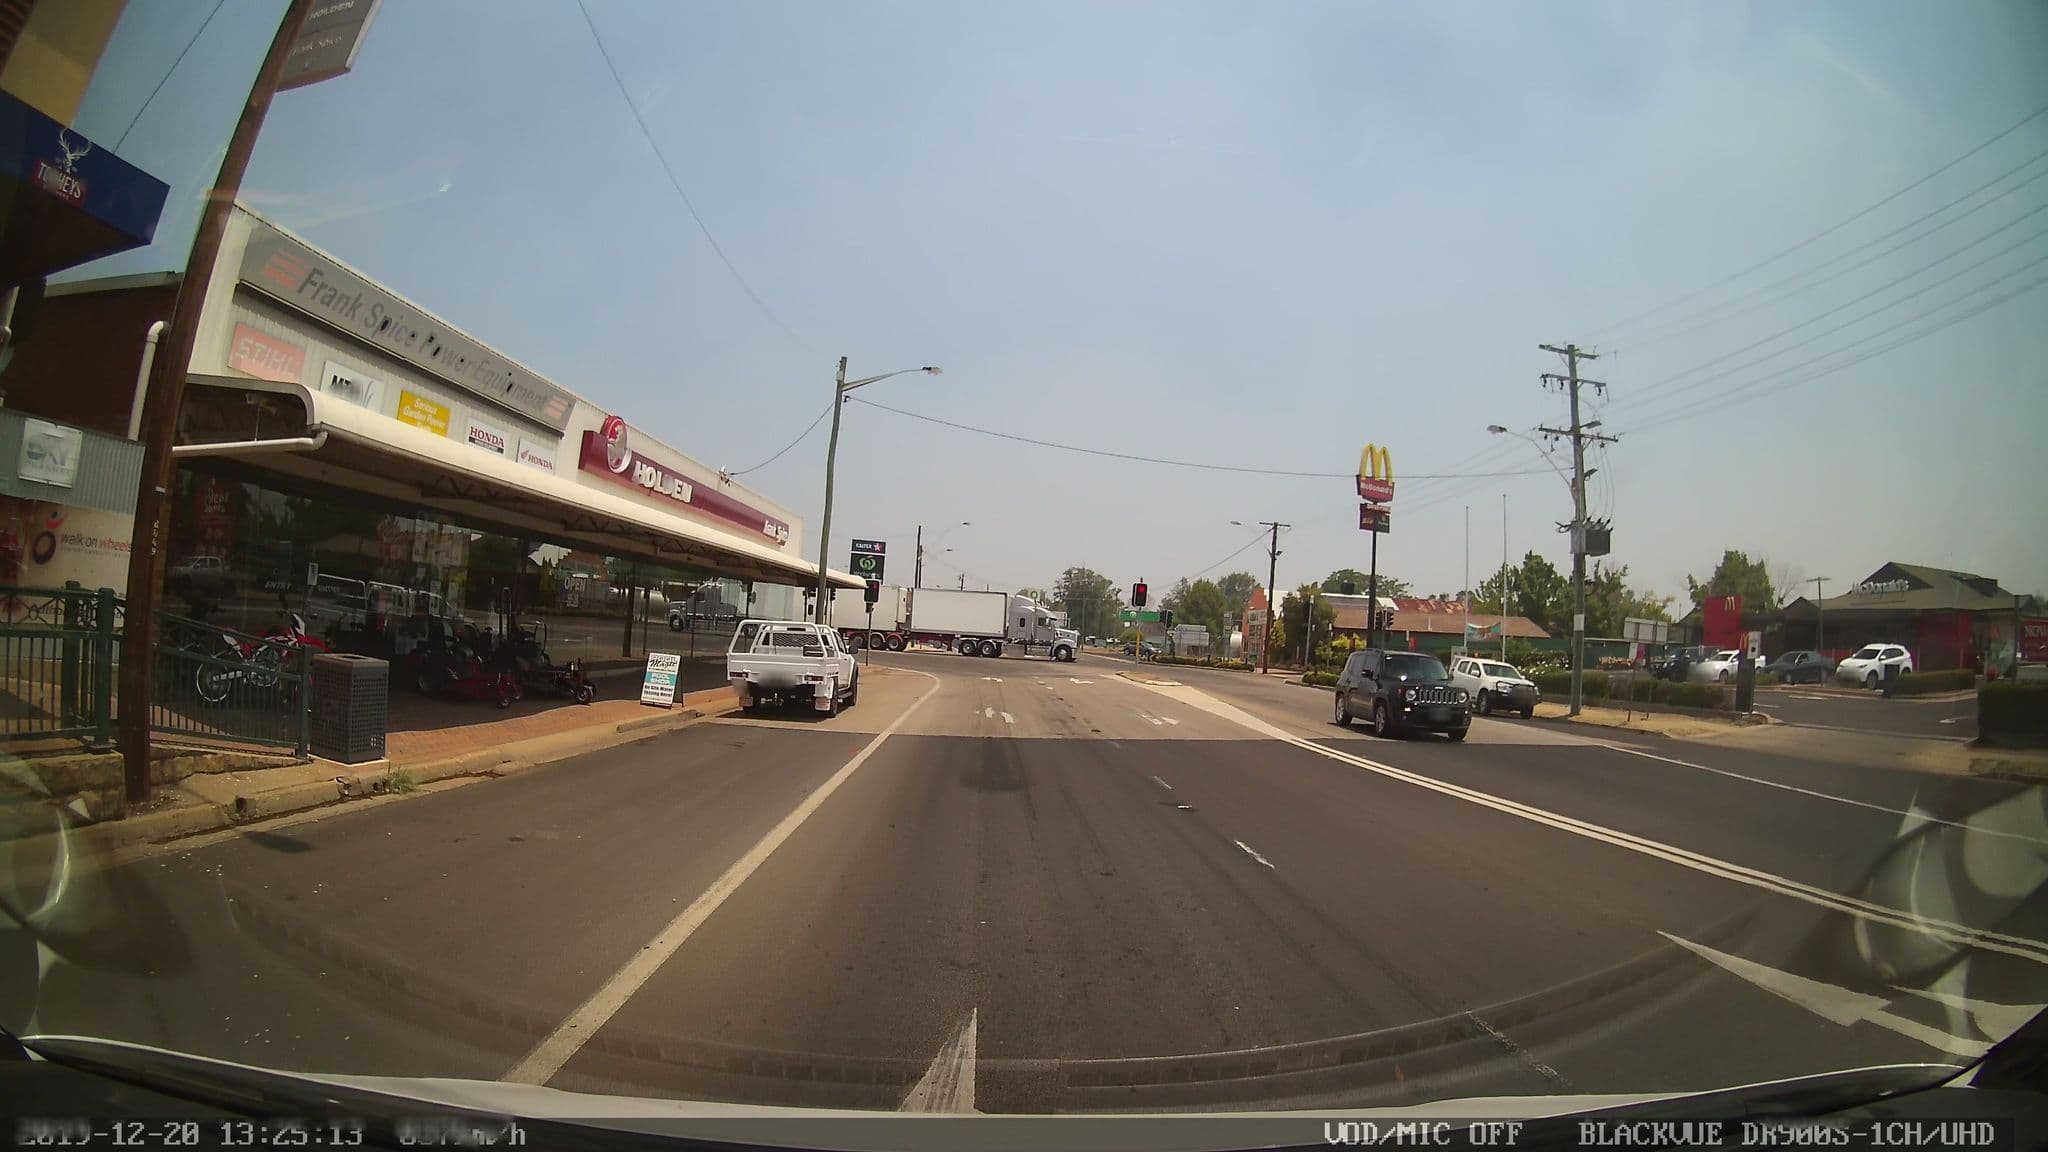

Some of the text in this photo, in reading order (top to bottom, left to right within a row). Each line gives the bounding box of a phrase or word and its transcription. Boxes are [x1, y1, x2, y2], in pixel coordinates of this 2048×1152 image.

[38, 162, 81, 198] THEYS
[297, 267, 549, 408] Frank Spice Power Equipment
[235, 336, 295, 379] STIHL
[470, 426, 504, 448] HONDA
[528, 454, 553, 470] HONDA
[632, 460, 693, 503] HOLEN
[62, 533, 85, 547] walk
[86, 538, 98, 549] on
[100, 536, 133, 553] wheels
